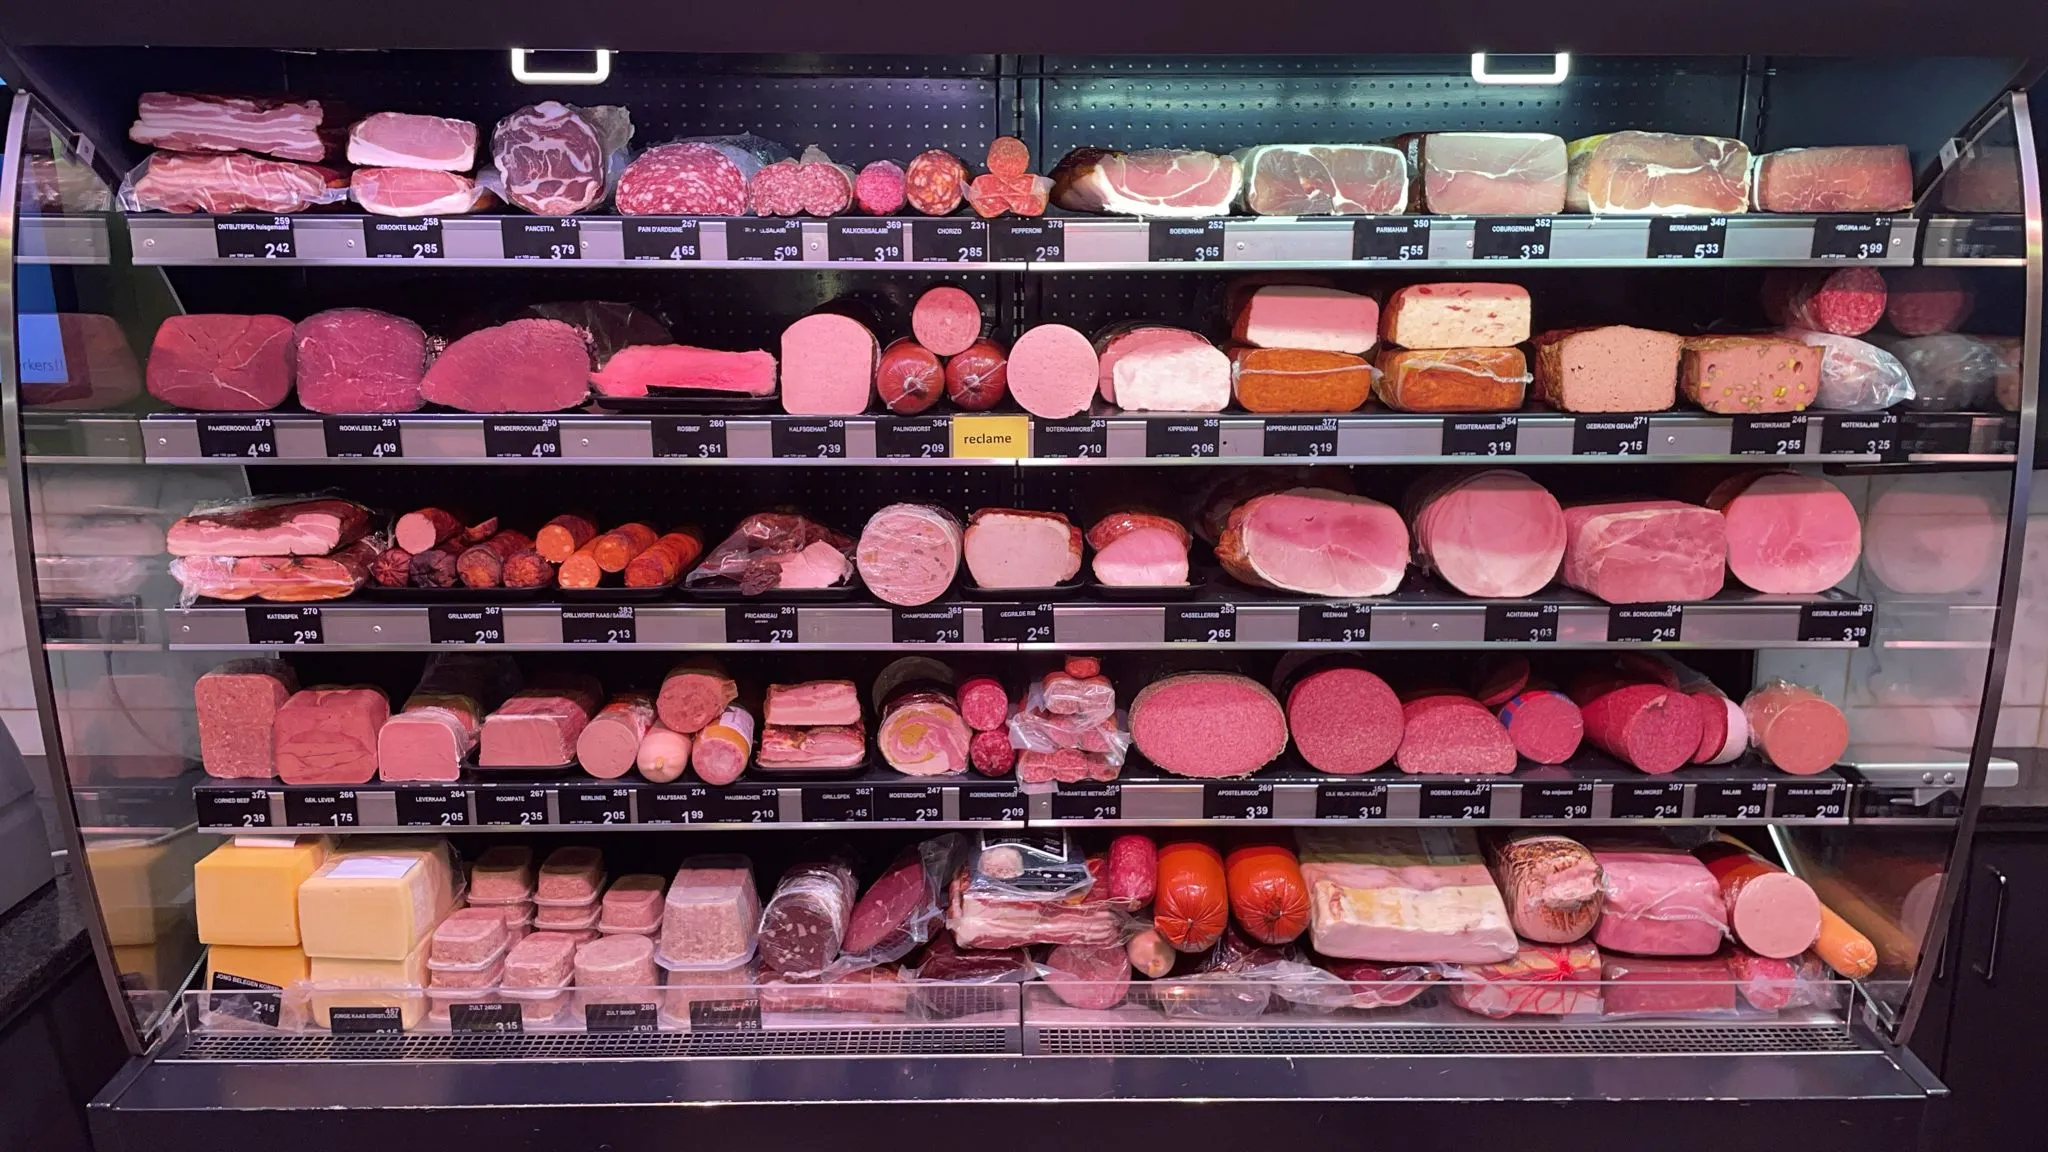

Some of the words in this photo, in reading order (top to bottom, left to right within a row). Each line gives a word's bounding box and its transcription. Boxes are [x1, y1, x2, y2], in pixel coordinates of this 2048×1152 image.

[274, 216, 290, 225] 259
[423, 217, 439, 226] 258
[785, 220, 800, 228] 291
[1047, 220, 1063, 228] 378
[1413, 219, 1429, 228] 350
[1535, 218, 1551, 227] 352
[1710, 218, 1726, 226] 348
[970, 221, 986, 230] 231
[1208, 221, 1224, 229] 252
[1491, 225, 1535, 233] COBURGERHAM
[937, 227, 962, 235] CHORIZO
[255, 419, 271, 427] 275
[381, 419, 397, 427] 251
[542, 419, 557, 427] 250
[932, 419, 947, 427] 364
[1203, 419, 1219, 427] 355
[1321, 418, 1337, 426] 377
[1501, 417, 1516, 426] 354
[1633, 417, 1648, 425] 271
[788, 425, 828, 433] KALFSGEHAKT
[1167, 425, 1199, 433] KIPPENHAM
[1314, 424, 1336, 432] KEUKEN
[963, 432, 1012, 444] reclame
[302, 607, 318, 615] 270
[485, 607, 500, 615] 367
[781, 606, 796, 614] 261
[947, 606, 962, 615] 365
[1037, 604, 1053, 612] 475
[744, 612, 778, 620] FRICANDEAU
[1619, 610, 1633, 618] GEK.
[1633, 610, 1673, 618] SCHOUDERHAM
[926, 786, 942, 795] 247
[1258, 784, 1273, 792] 269
[1668, 783, 1683, 792] 357
[450, 790, 465, 798] 264
[530, 789, 544, 798] 267
[613, 789, 628, 797] 265
[691, 788, 706, 796] 274
[762, 789, 777, 797] 273
[1217, 789, 1259, 797] APOSTELBROOD
[216, 973, 232, 982] JONG
[232, 976, 258, 988] BELEGEN
[745, 999, 759, 1007] 277
